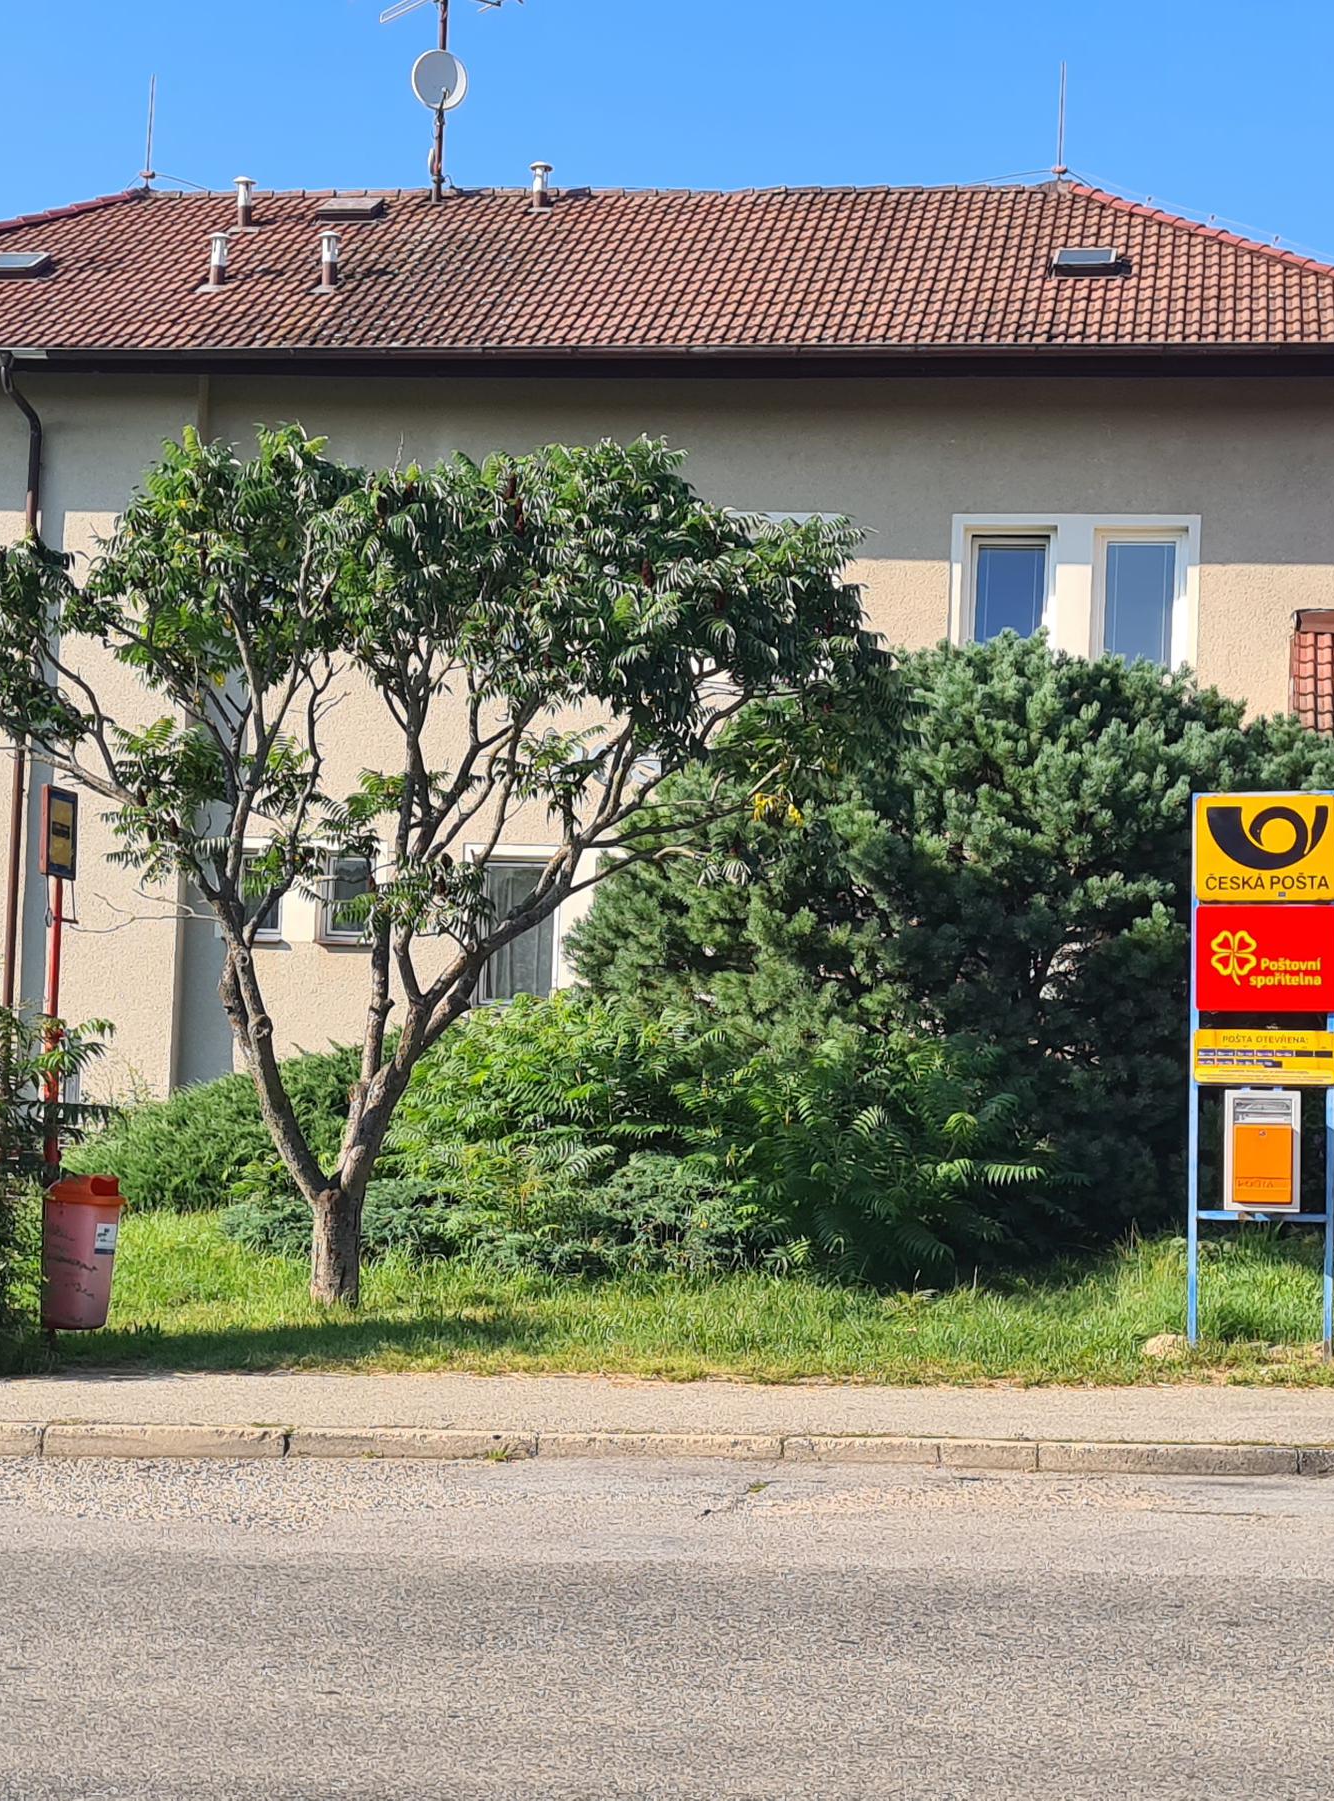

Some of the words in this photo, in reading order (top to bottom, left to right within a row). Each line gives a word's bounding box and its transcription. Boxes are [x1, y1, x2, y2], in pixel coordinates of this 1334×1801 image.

[1205, 873, 1265, 891] ČESKÁ
[1270, 872, 1329, 890] POŠTA
[1260, 957, 1321, 971] Poštovní
[1249, 973, 1322, 988] spořitelna
[1222, 1033, 1252, 1044] POŠTA
